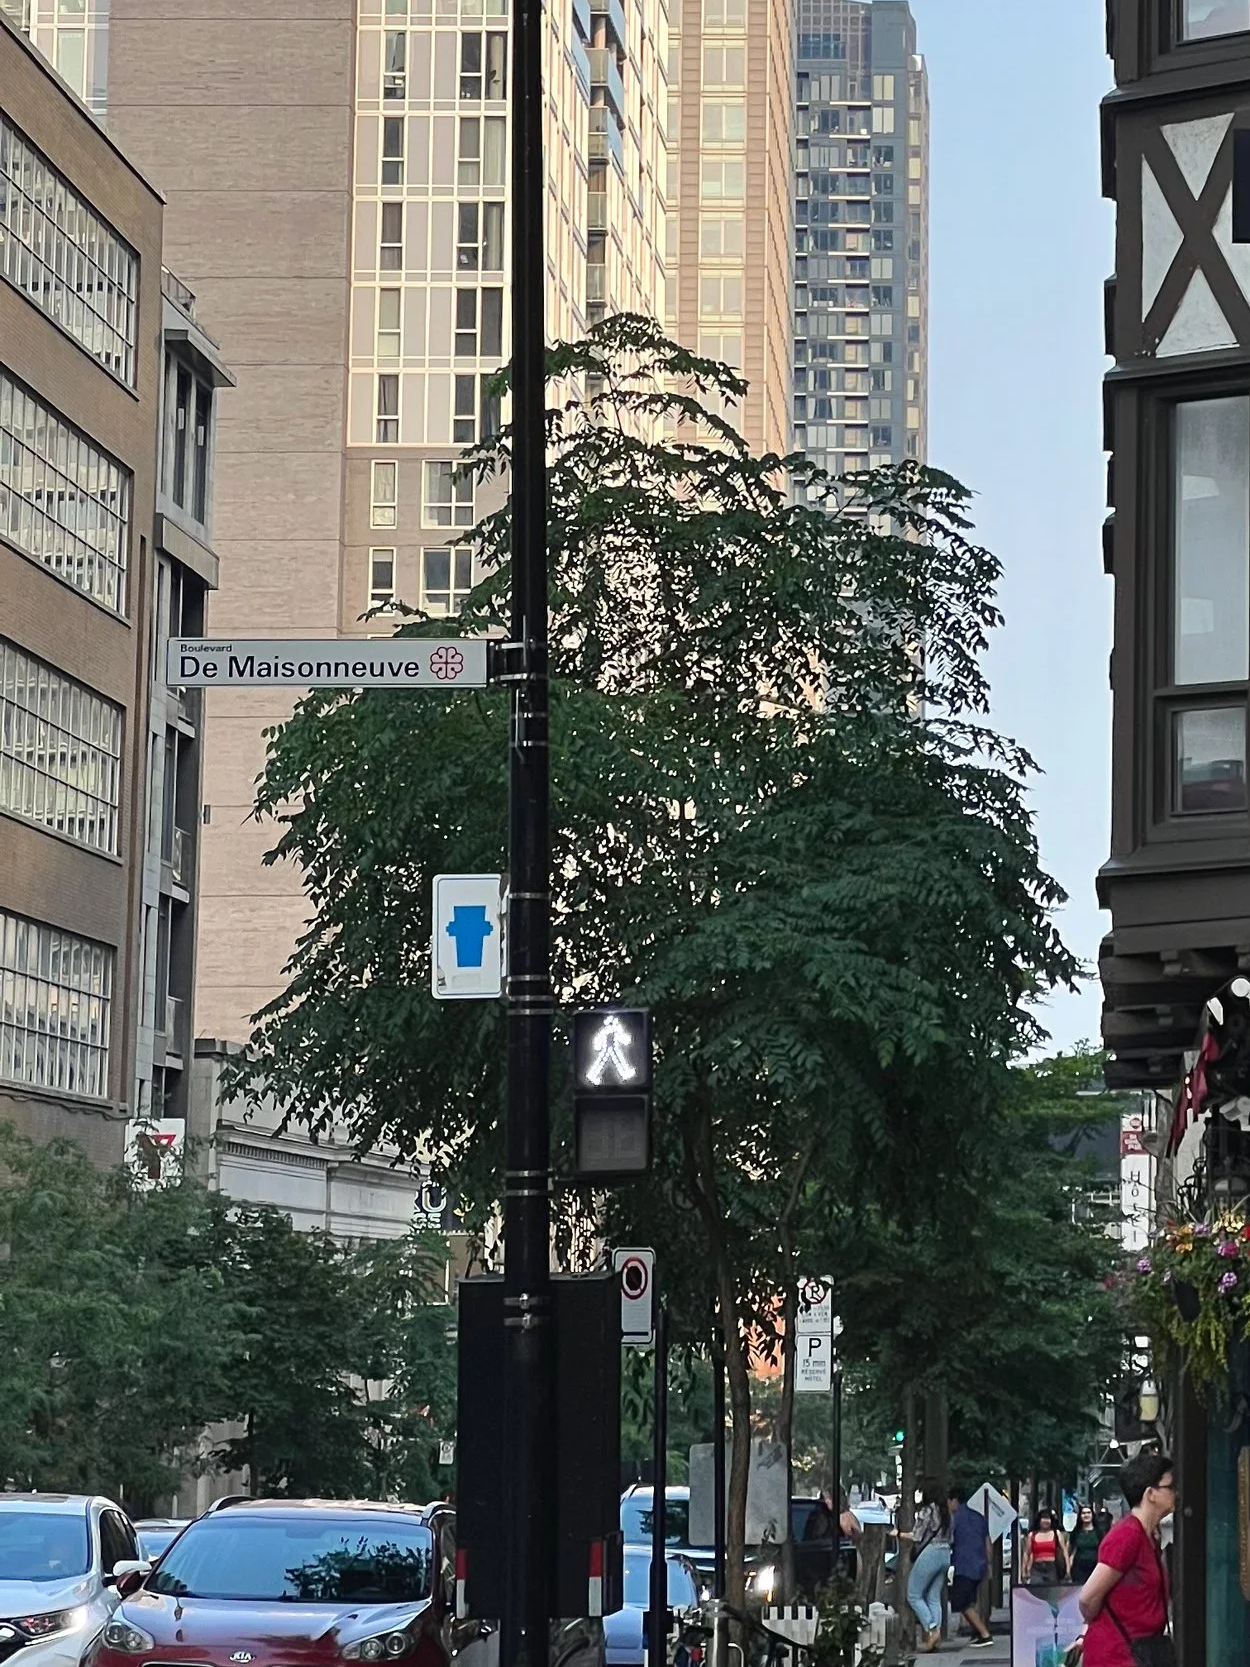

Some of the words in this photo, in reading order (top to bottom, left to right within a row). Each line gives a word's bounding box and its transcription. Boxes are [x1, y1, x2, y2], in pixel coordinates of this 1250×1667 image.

[180, 643, 233, 653] Boulevard
[180, 655, 218, 679] De
[228, 655, 420, 679] Maisonneuve
[808, 1337, 822, 1357] P
[230, 1650, 252, 1661] KIA
